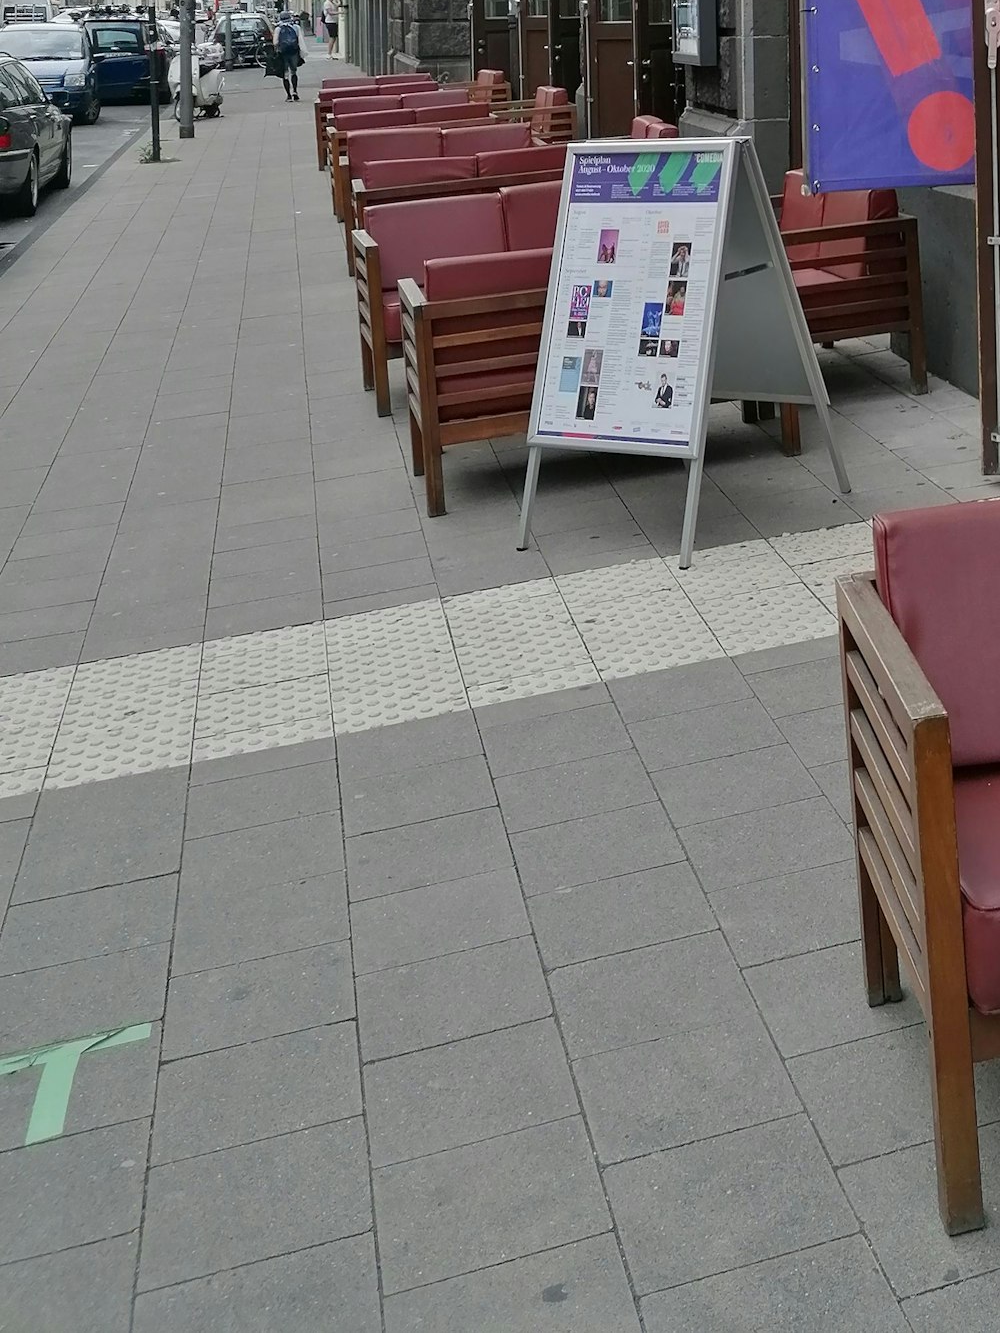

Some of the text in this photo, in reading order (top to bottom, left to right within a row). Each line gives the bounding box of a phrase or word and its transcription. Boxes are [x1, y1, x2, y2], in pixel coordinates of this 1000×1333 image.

[578, 155, 611, 166] Spielplan
[697, 153, 724, 164] COMEDIA
[577, 164, 602, 175] August
[606, 164, 635, 174] Oktober
[637, 163, 655, 173] 2020
